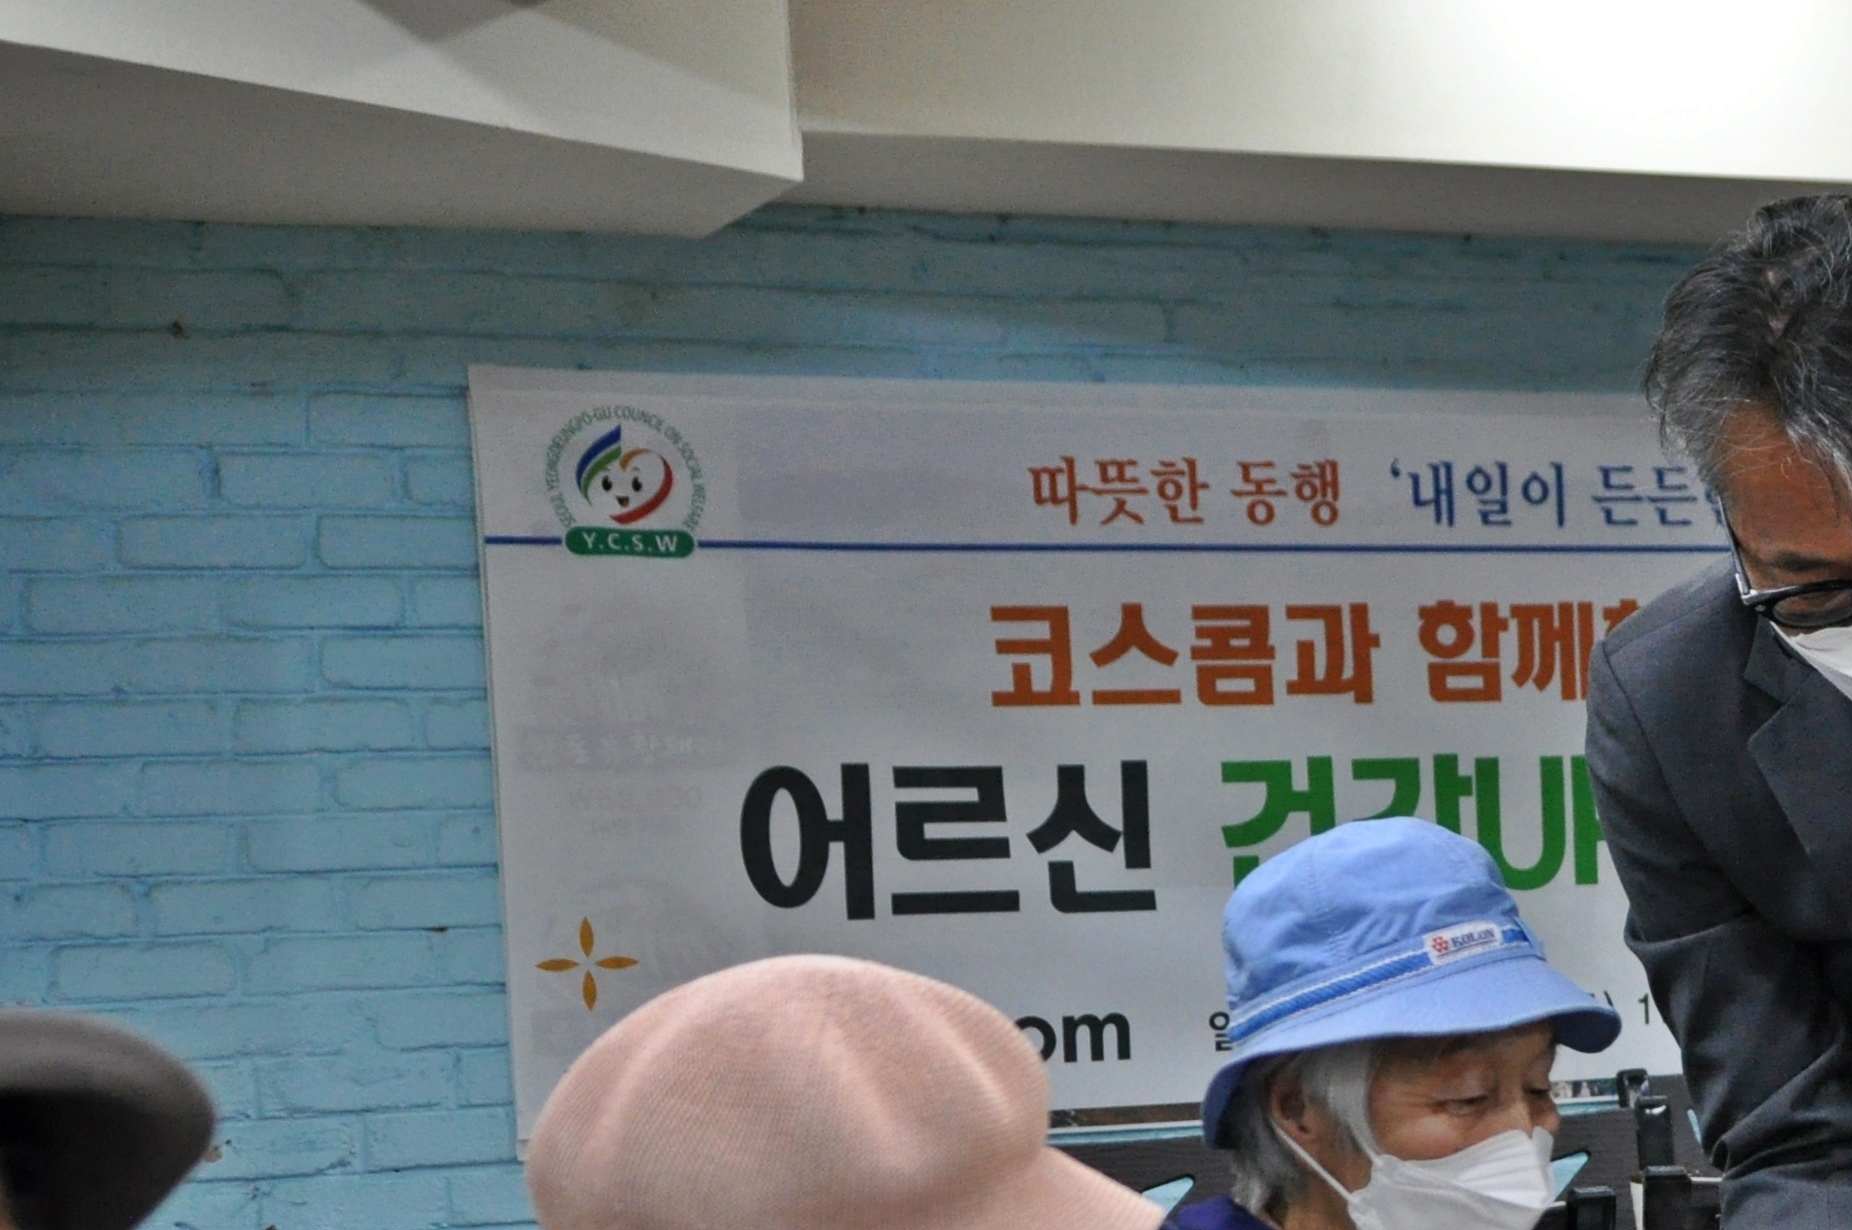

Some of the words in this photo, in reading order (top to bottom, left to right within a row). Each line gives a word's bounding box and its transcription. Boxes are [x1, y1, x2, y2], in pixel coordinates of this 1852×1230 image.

[1027, 455, 1210, 526] 따뜻한
[1230, 459, 1340, 526] 동행
[1390, 458, 1565, 528] ‘내일이
[582, 531, 679, 553] Y.C.S.W
[991, 602, 1381, 708] 코스콤과
[1418, 599, 1638, 704] 함께
[740, 759, 1157, 920] 어르신
[1451, 928, 1496, 949] KOLON
